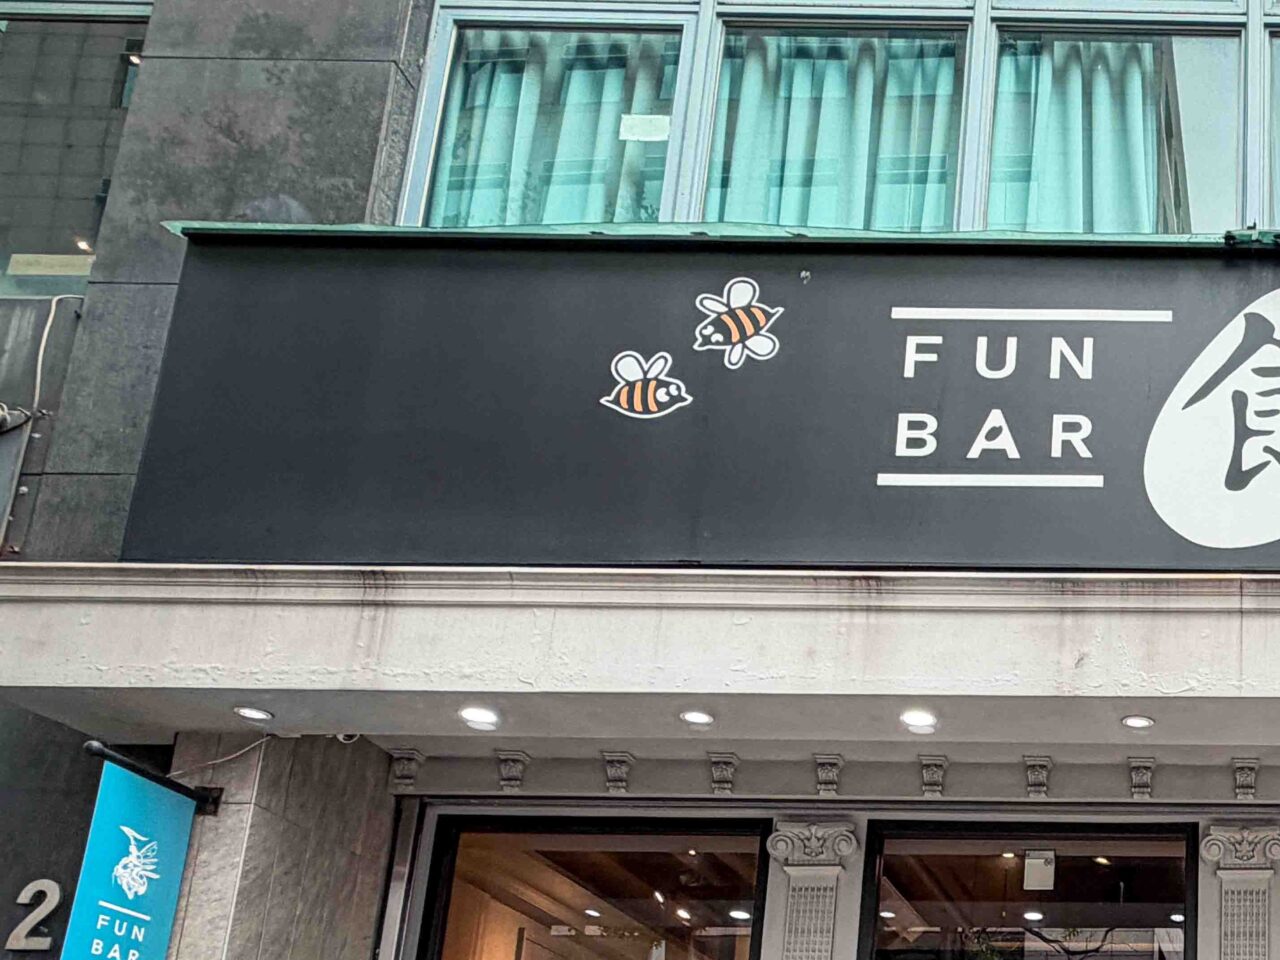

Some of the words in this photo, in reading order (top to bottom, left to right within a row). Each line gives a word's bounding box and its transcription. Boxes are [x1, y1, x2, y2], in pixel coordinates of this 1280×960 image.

[903, 335, 1094, 380] FUN
[894, 408, 1093, 459] BAR
[5, 878, 60, 950] 2
[96, 914, 146, 943] FUN
